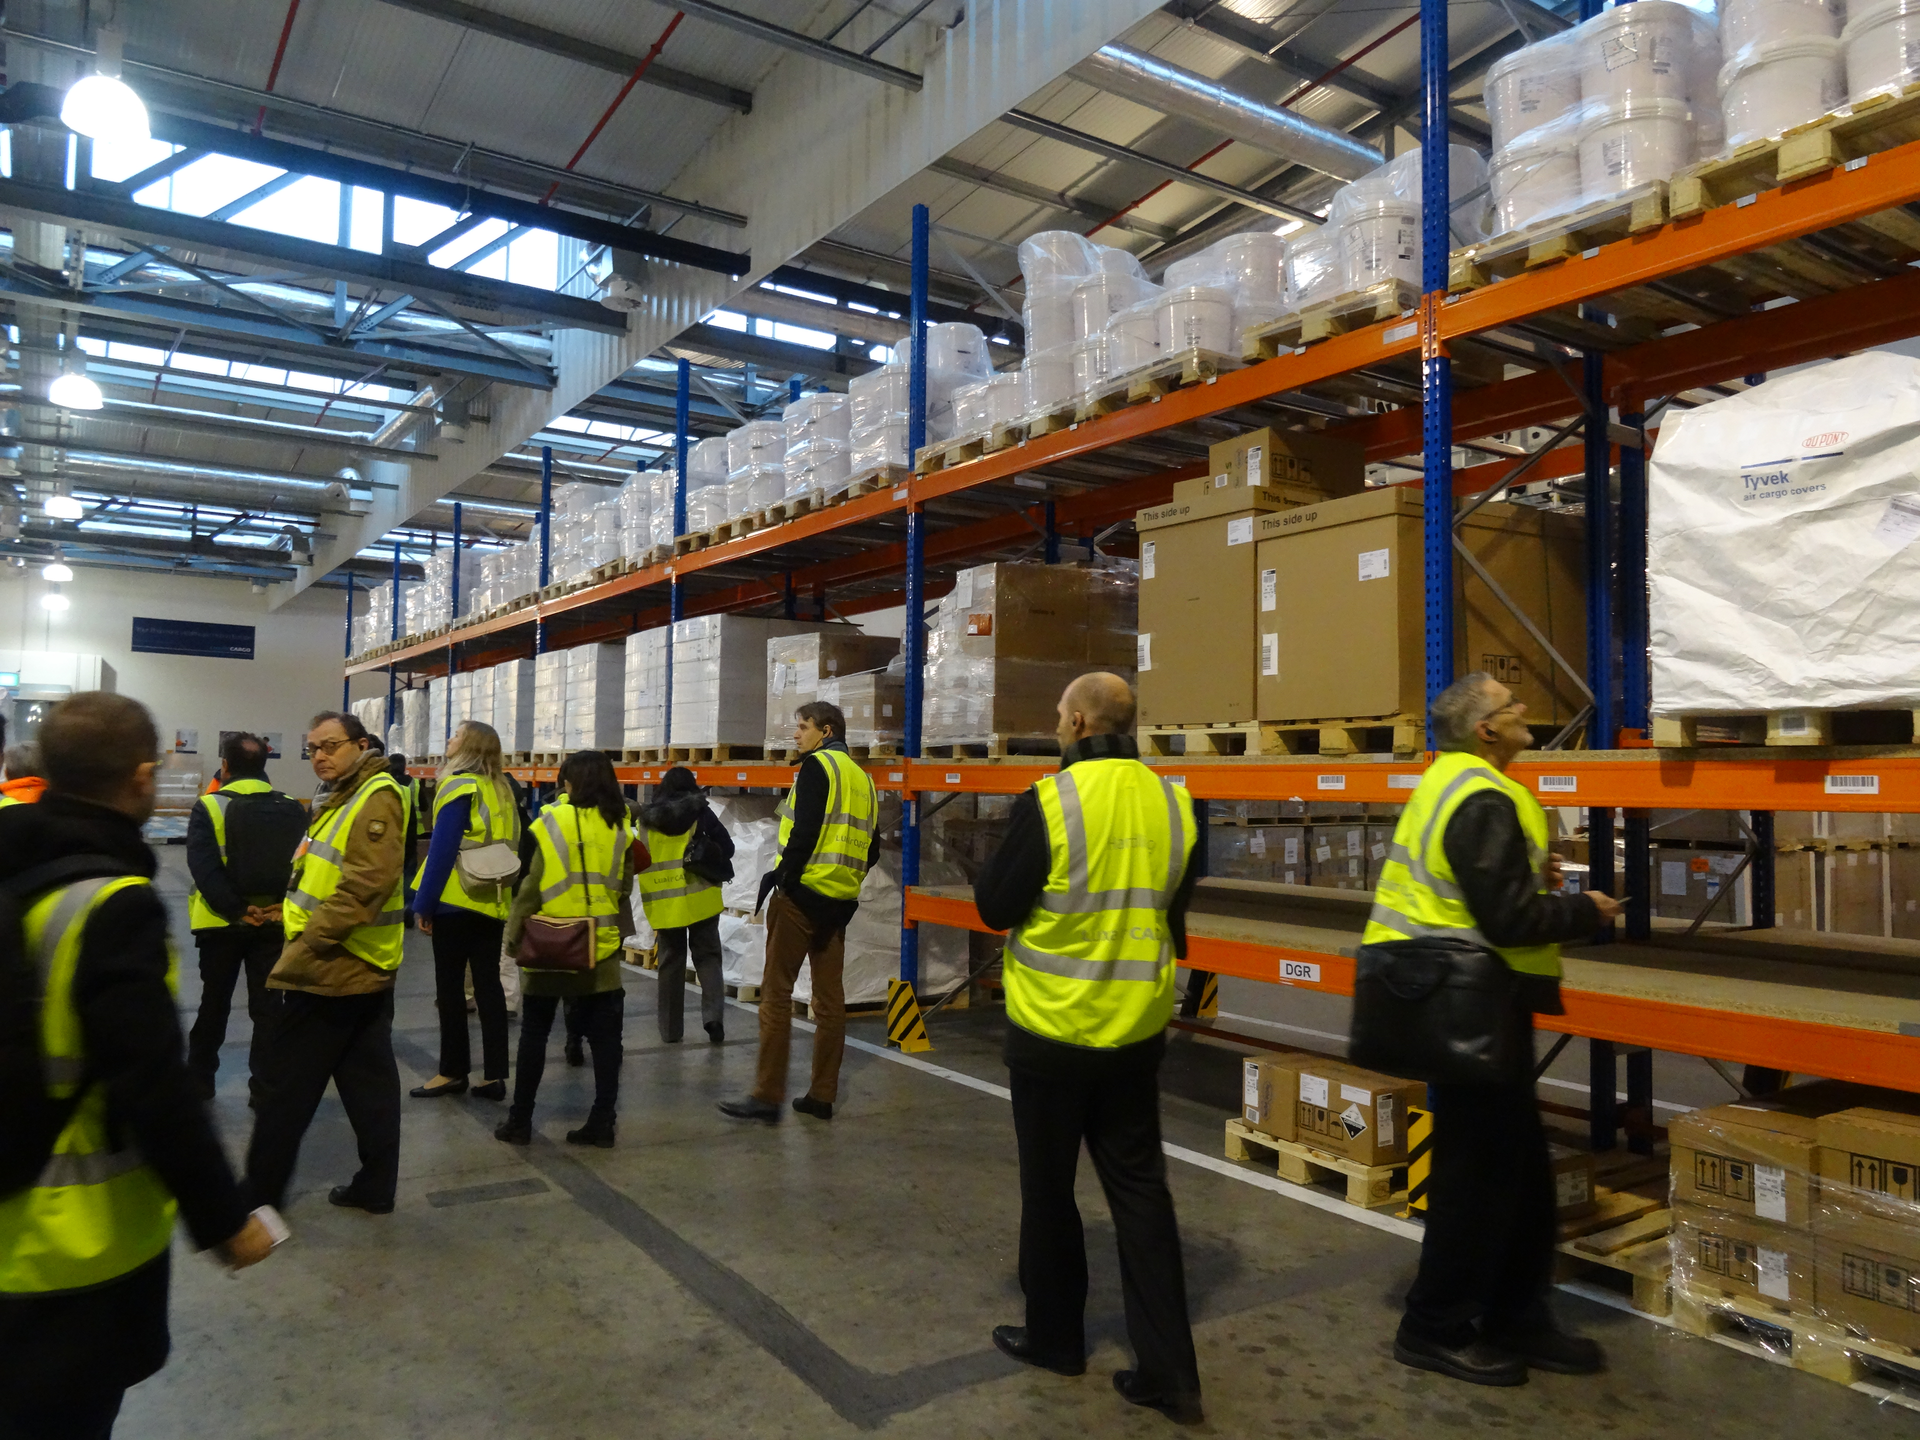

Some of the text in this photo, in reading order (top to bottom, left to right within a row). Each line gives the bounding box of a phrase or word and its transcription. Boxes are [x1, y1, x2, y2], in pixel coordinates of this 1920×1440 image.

[1741, 470, 1789, 491] Tyvek
[1262, 491, 1281, 503] This
[1743, 483, 1827, 501] air cargo covers
[1143, 506, 1190, 522] This side up
[1261, 511, 1318, 530] This side up
[1285, 963, 1311, 979] DGR
